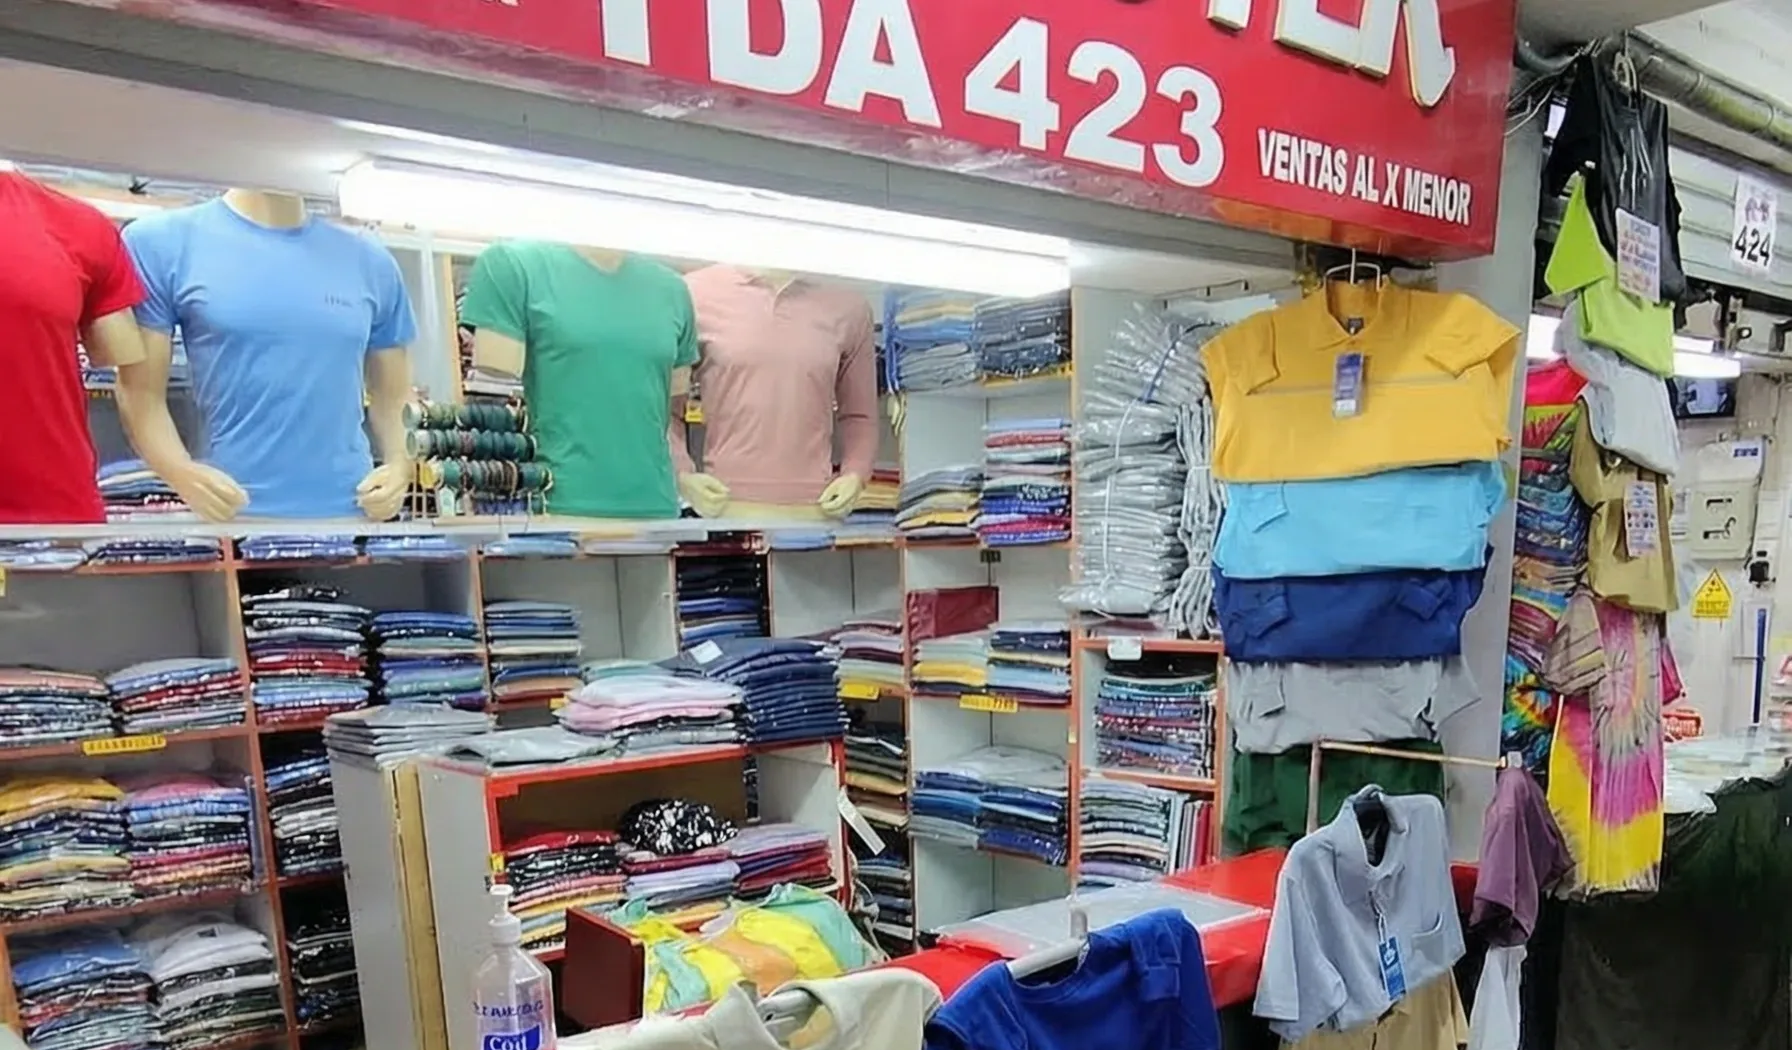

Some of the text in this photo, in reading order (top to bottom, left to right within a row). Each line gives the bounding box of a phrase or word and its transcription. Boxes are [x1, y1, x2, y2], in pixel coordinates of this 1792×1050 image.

[964, 16, 1225, 188] 423
[1257, 127, 1472, 226] VENTAS AL X MENOR
[1734, 224, 1771, 267] 424
